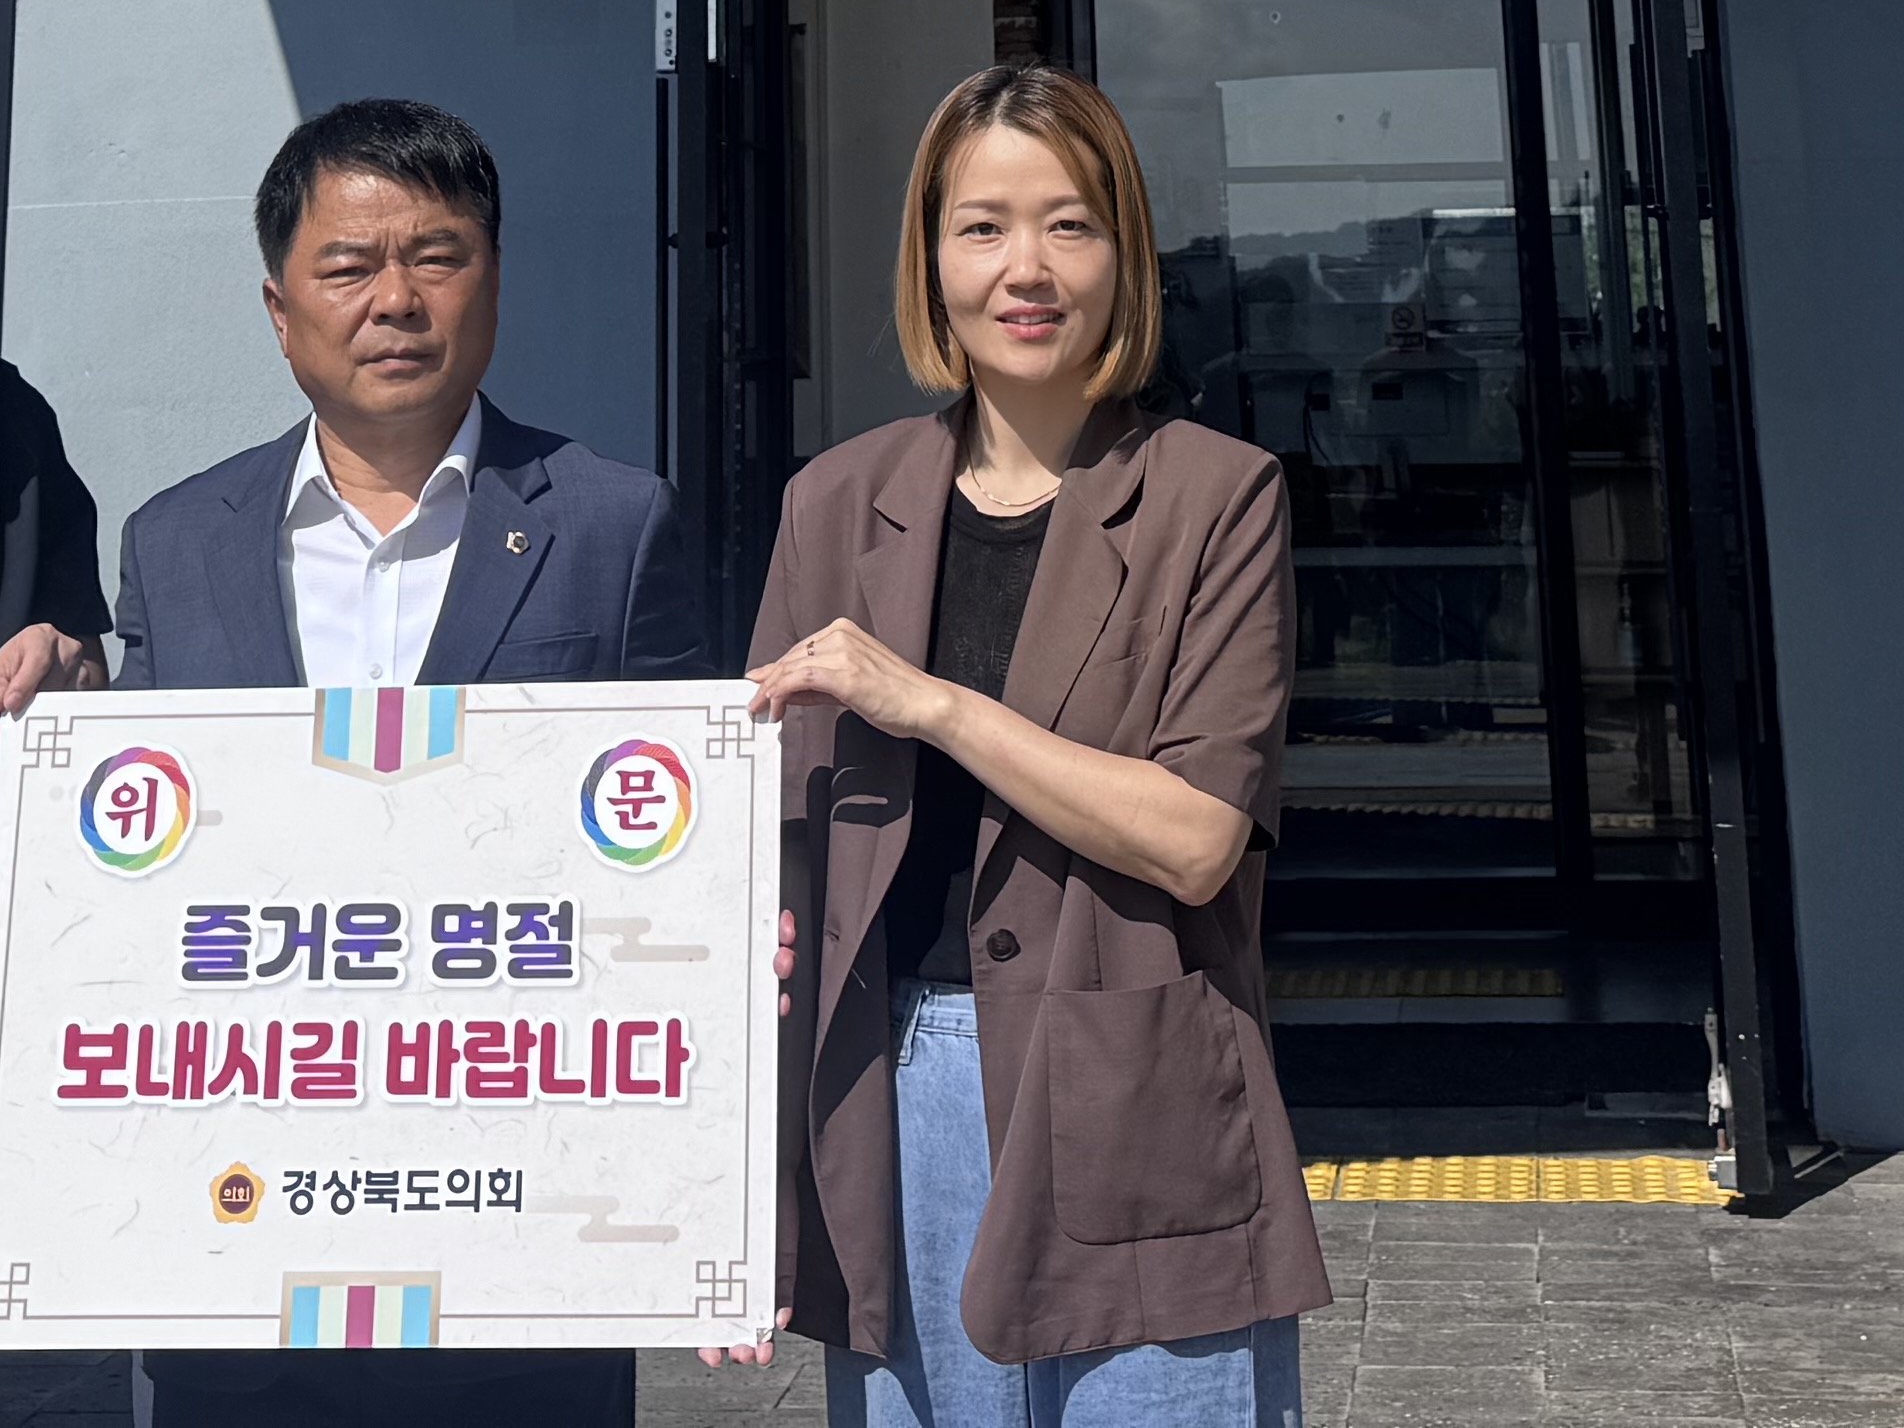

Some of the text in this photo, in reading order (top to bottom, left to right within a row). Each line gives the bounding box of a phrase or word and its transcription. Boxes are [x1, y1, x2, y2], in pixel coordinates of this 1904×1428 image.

[104, 769, 667, 844] 위 문
[180, 899, 575, 983] 즐거운 명절
[56, 1018, 691, 1102] 보내시길 바랍니다
[221, 1185, 251, 1203] 의회
[282, 1168, 523, 1216] 경상북도의회
